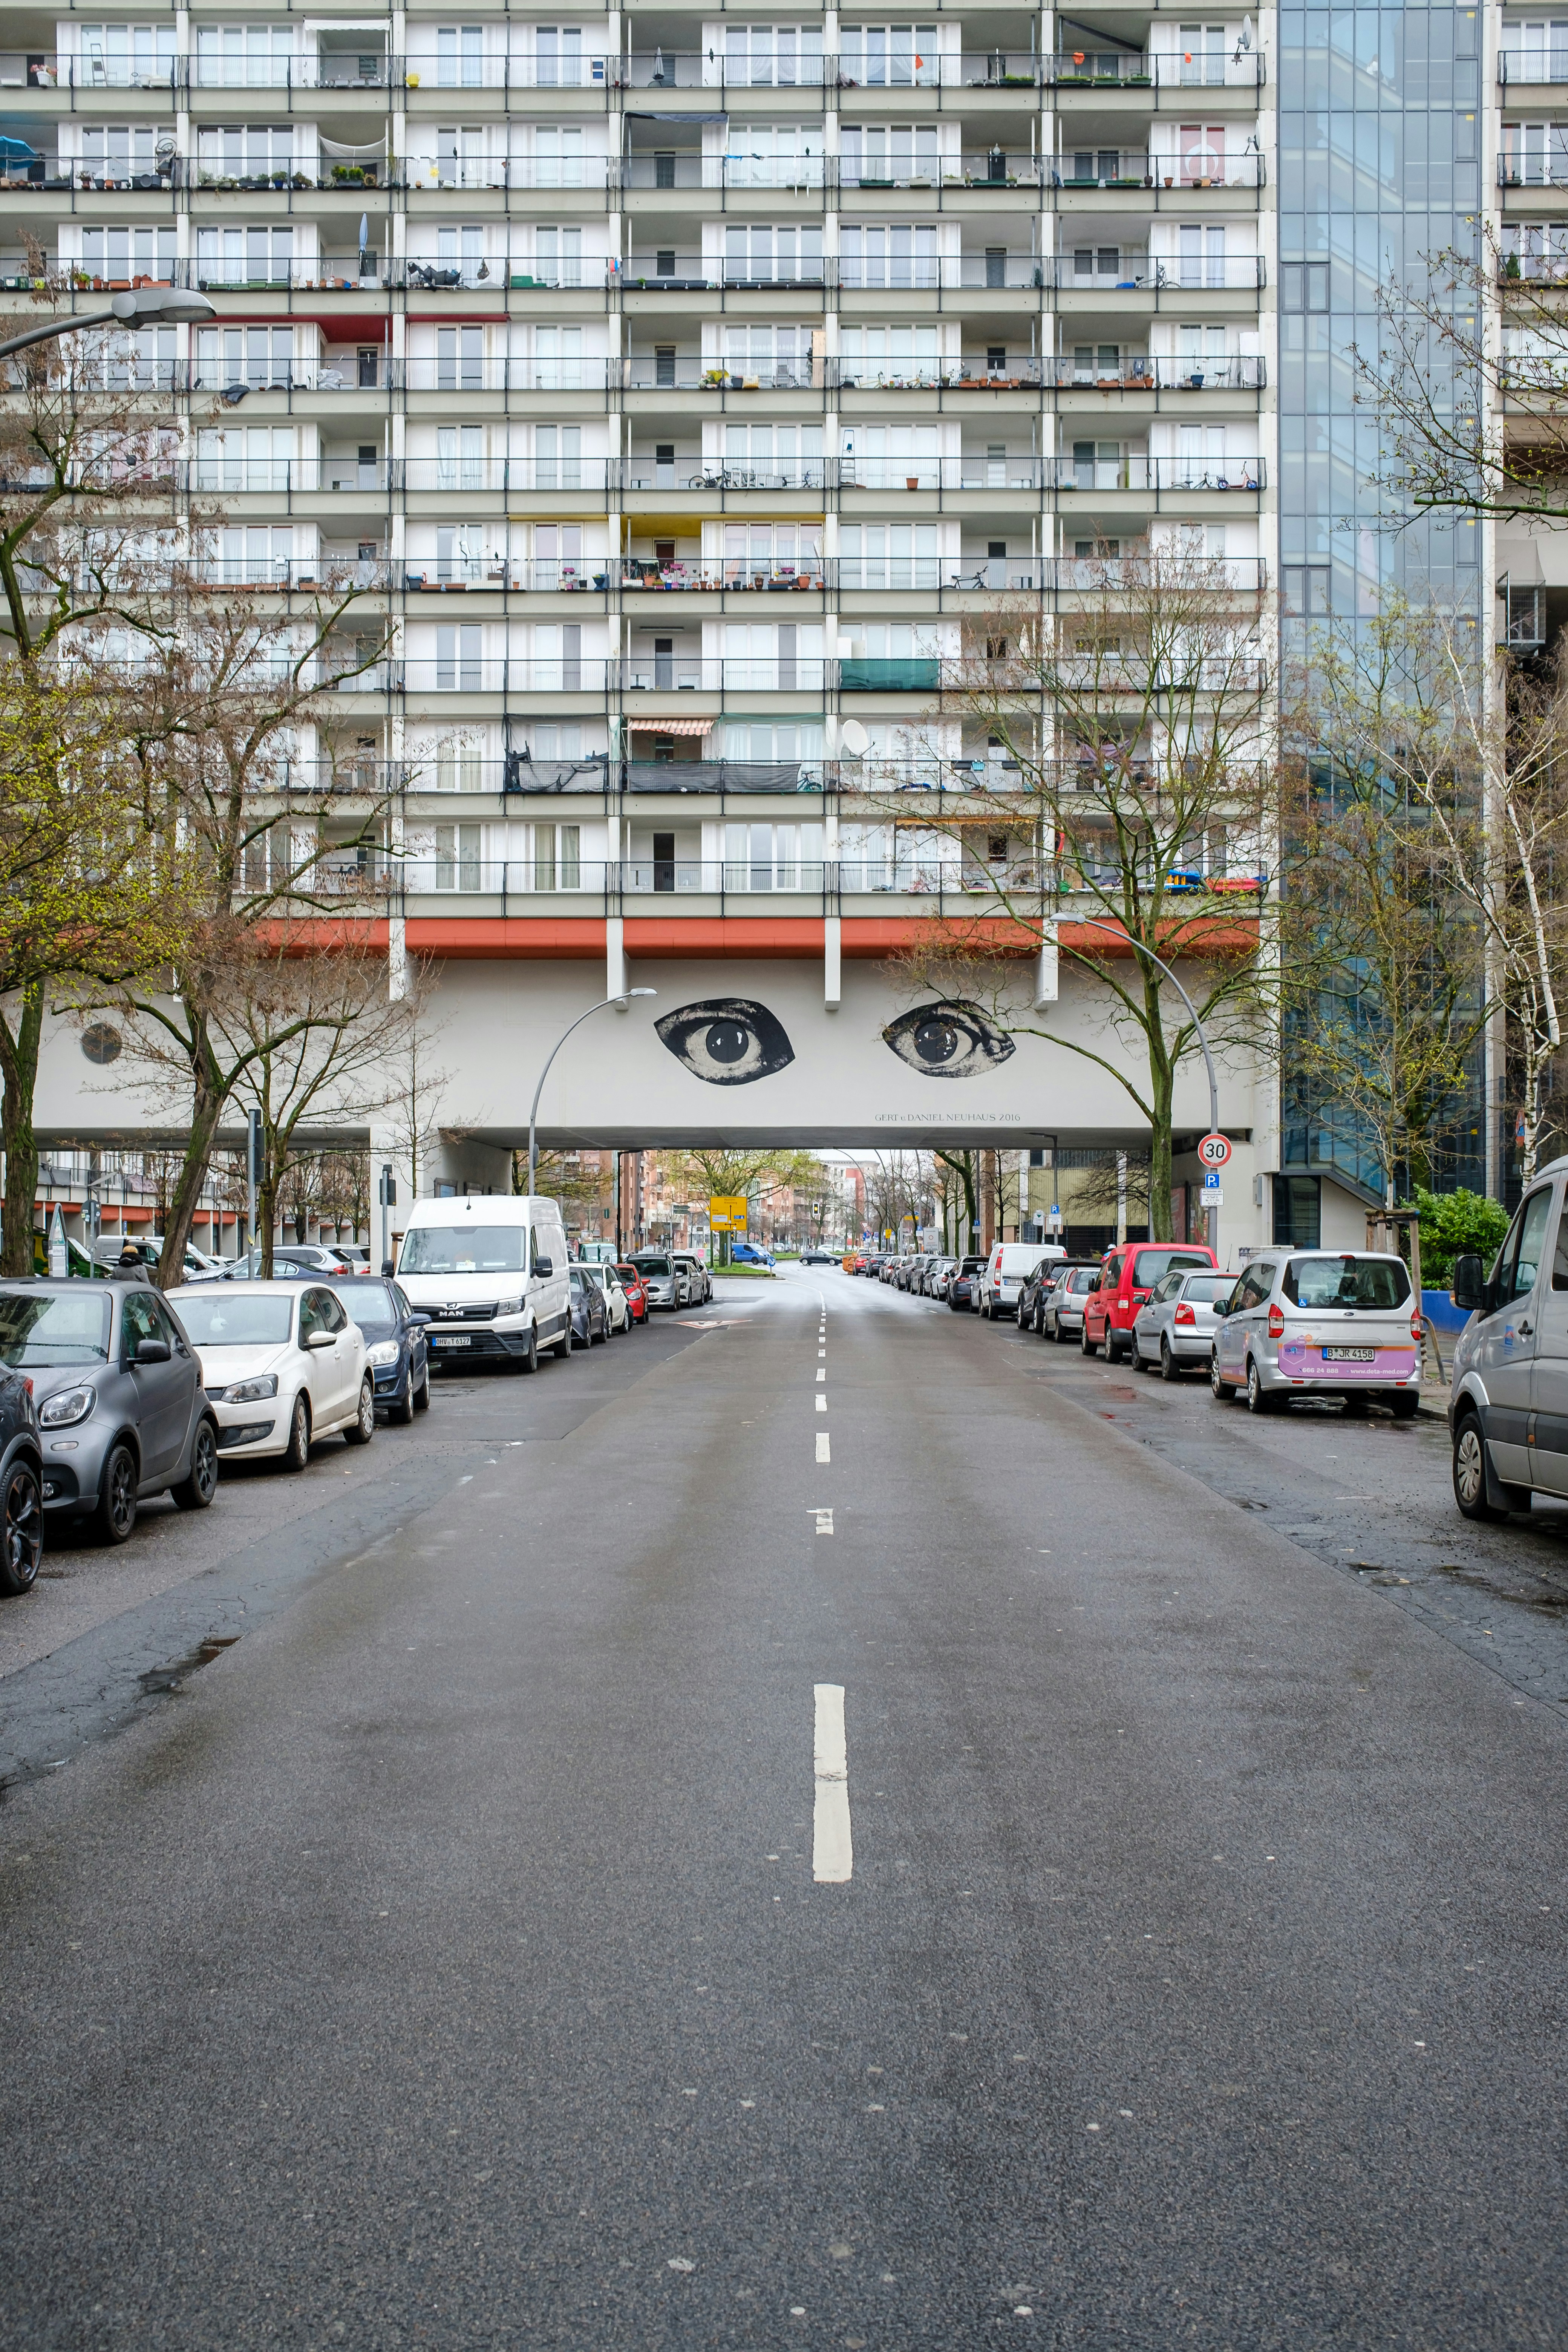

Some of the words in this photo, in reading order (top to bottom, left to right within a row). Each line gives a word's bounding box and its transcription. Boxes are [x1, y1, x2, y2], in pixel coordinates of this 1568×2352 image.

[1206, 1143, 1225, 1158] 30
[1208, 1175, 1216, 1187] P
[1328, 1349, 1333, 1357] B
[1339, 1349, 1350, 1358] JR
[1352, 1350, 1373, 1358] 4158
